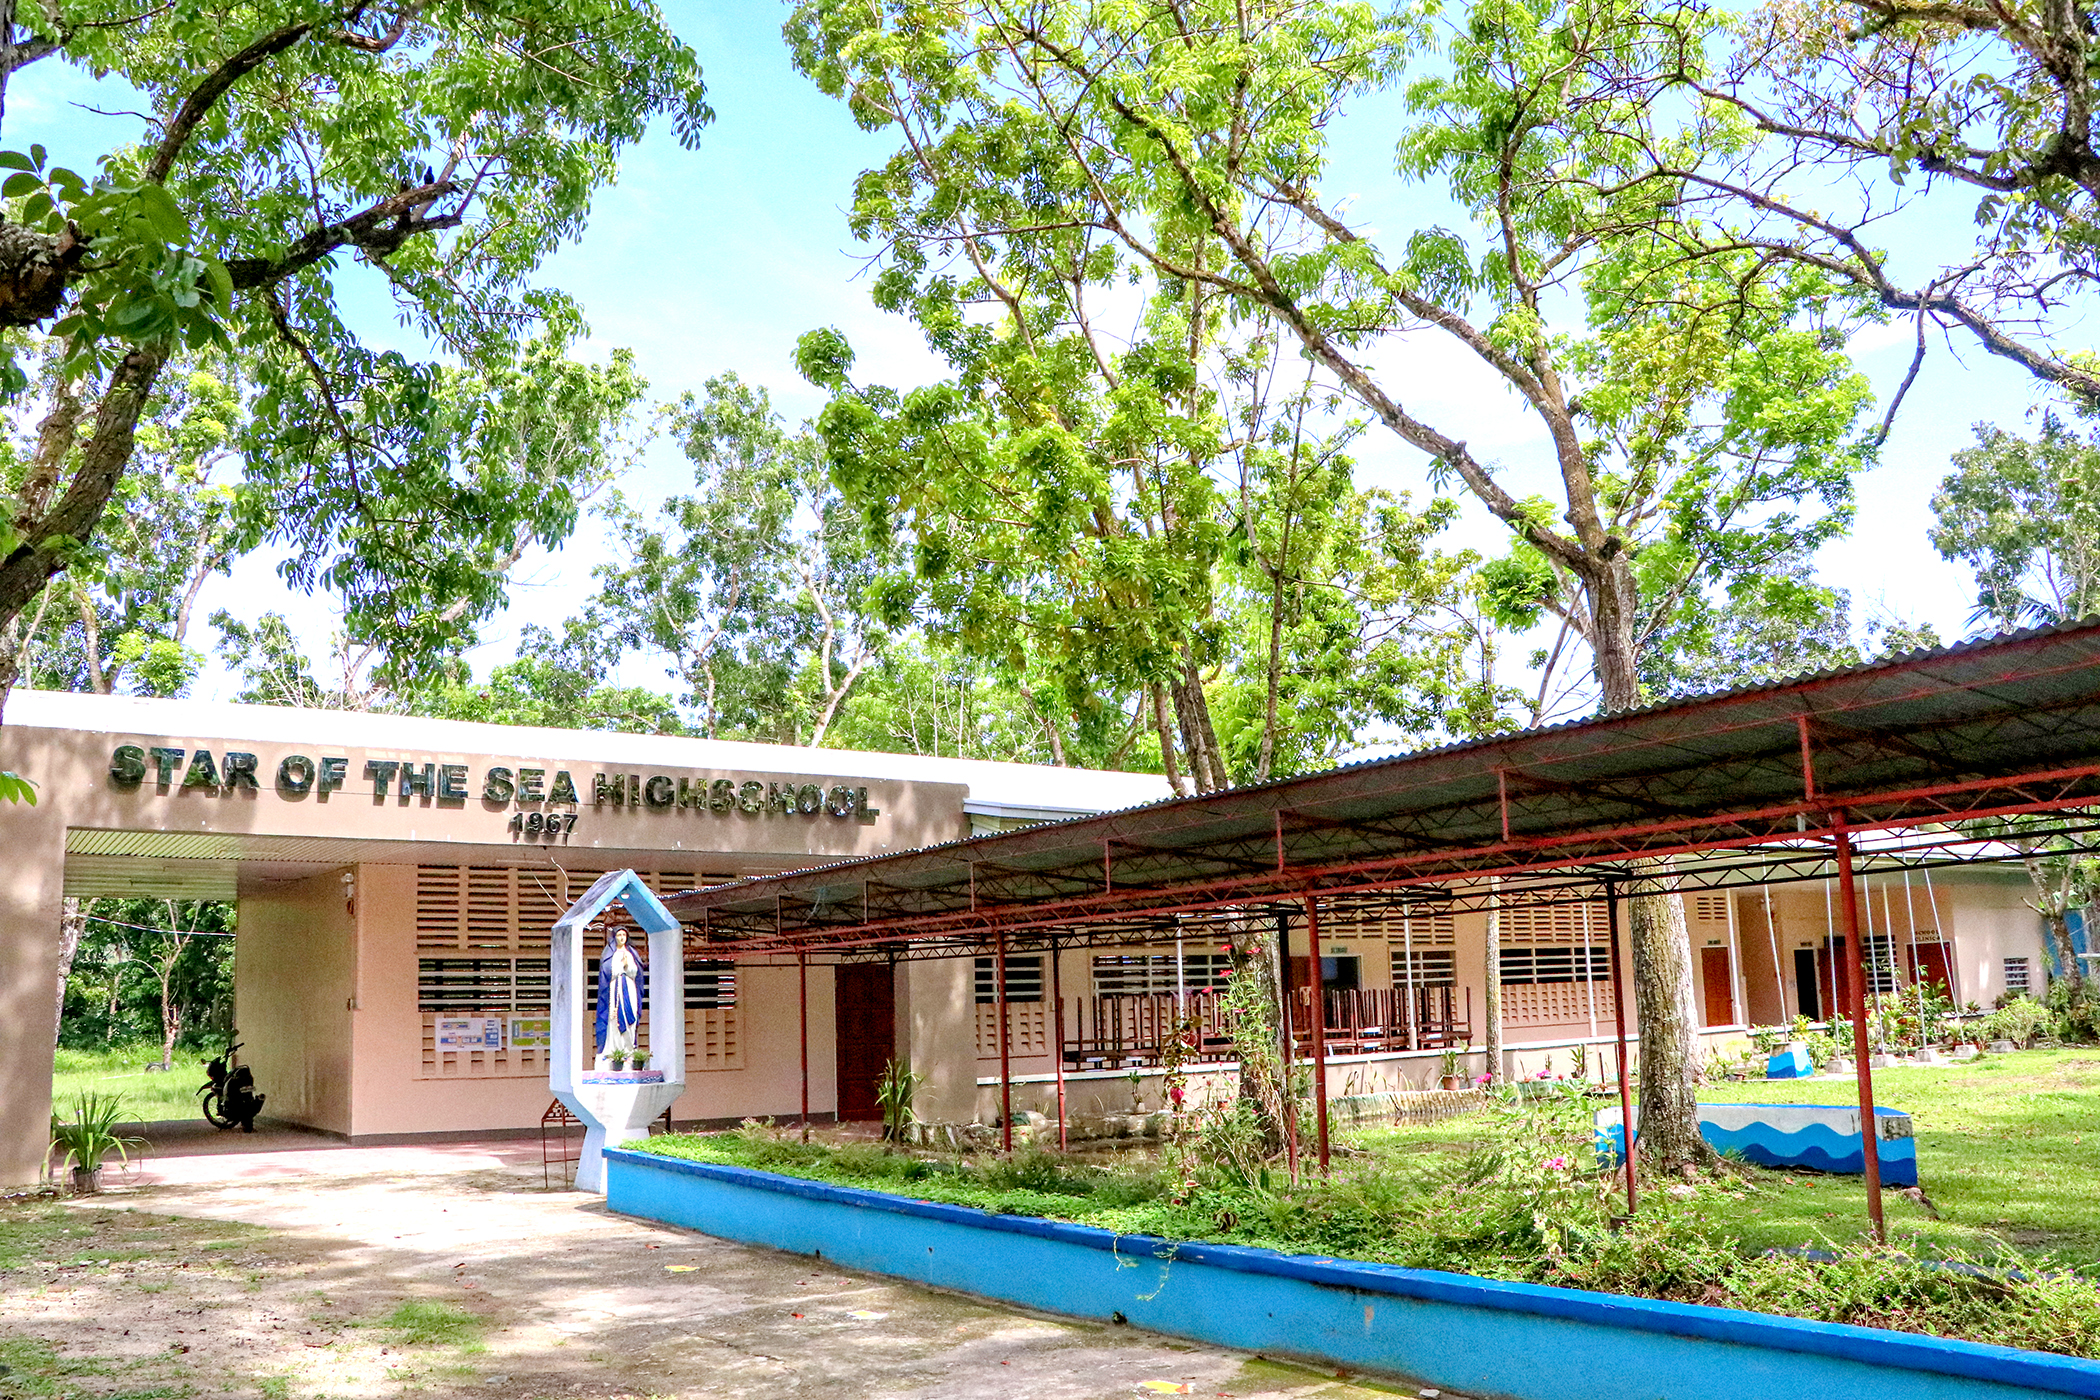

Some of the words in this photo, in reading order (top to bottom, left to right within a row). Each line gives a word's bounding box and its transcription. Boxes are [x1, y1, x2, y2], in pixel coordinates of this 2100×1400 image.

[110, 745, 259, 791] STAR
[278, 755, 348, 797] OF
[366, 760, 469, 799] THE
[485, 766, 579, 805] SEA
[513, 812, 578, 837] 1967
